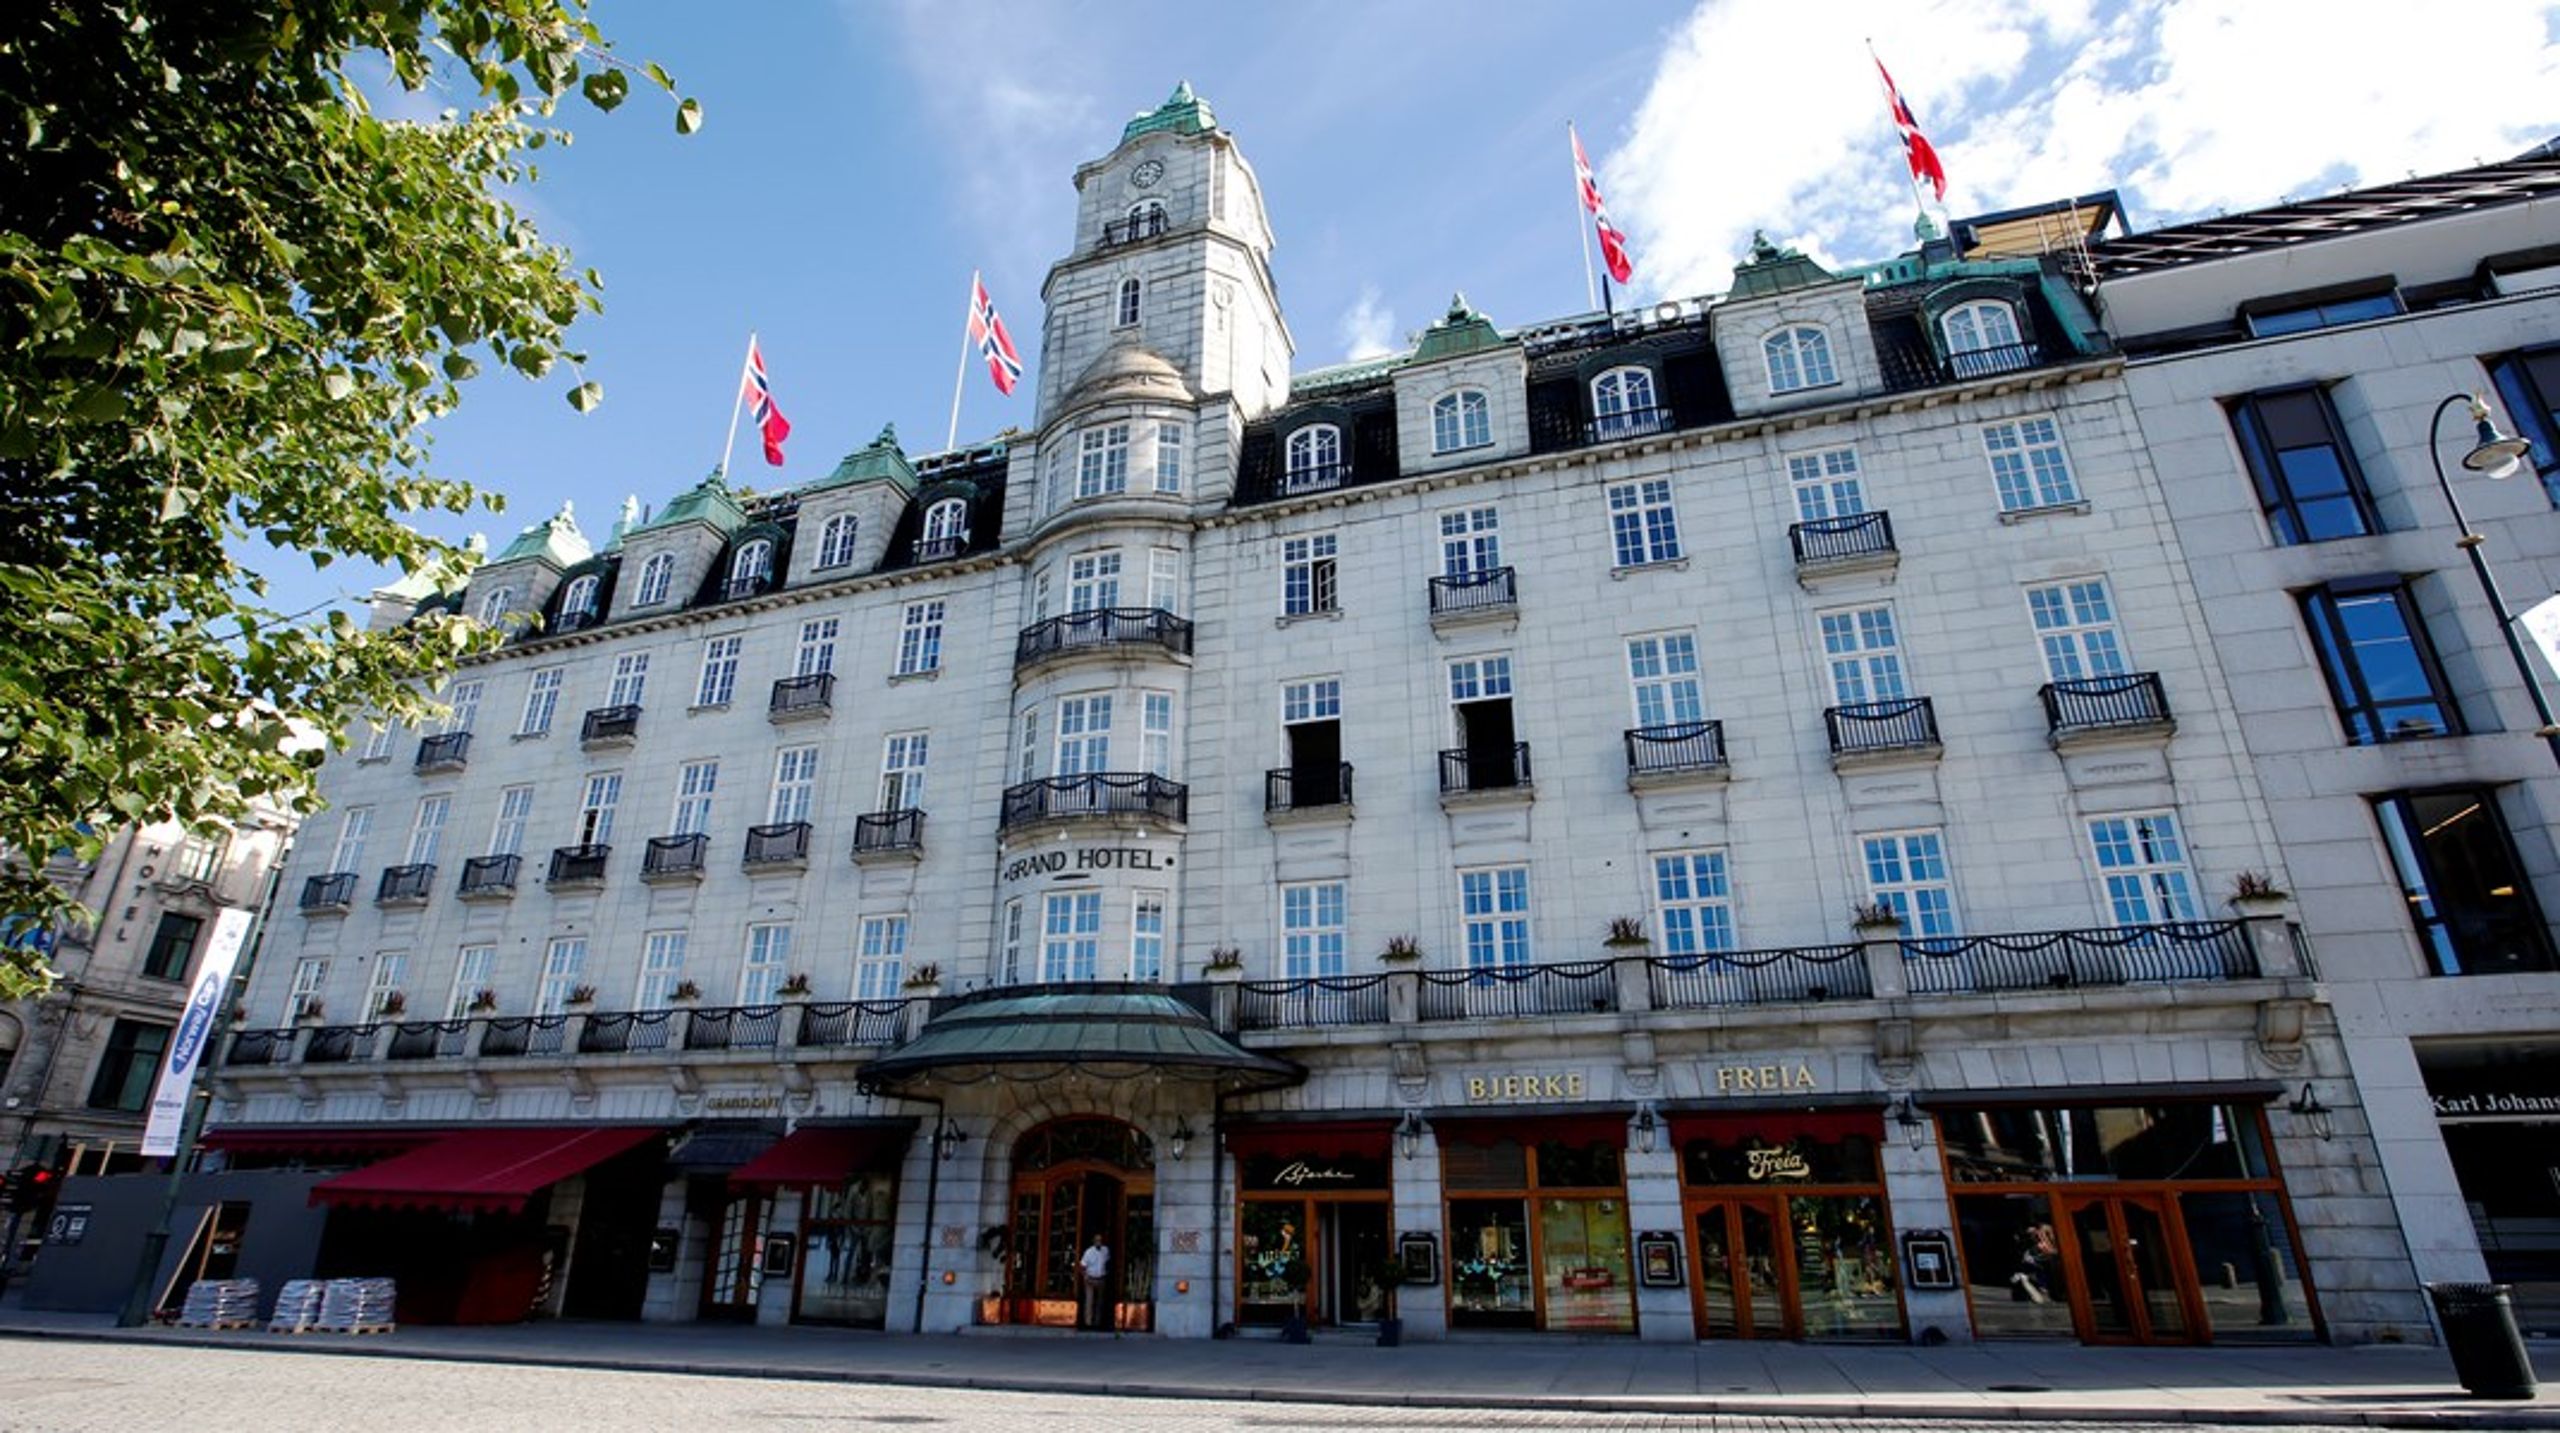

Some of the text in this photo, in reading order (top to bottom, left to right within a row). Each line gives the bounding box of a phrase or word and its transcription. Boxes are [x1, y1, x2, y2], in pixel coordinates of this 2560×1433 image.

[1007, 847, 1163, 881] GRAND HOTEL
[116, 845, 161, 942] HOTEL
[176, 978, 217, 1063] Norway Cup
[1469, 1073, 1586, 1100] BJERKE
[1717, 1064, 1816, 1090] FREIA
[2430, 1094, 2480, 1113] Karl
[1746, 1146, 1810, 1180] Freia
